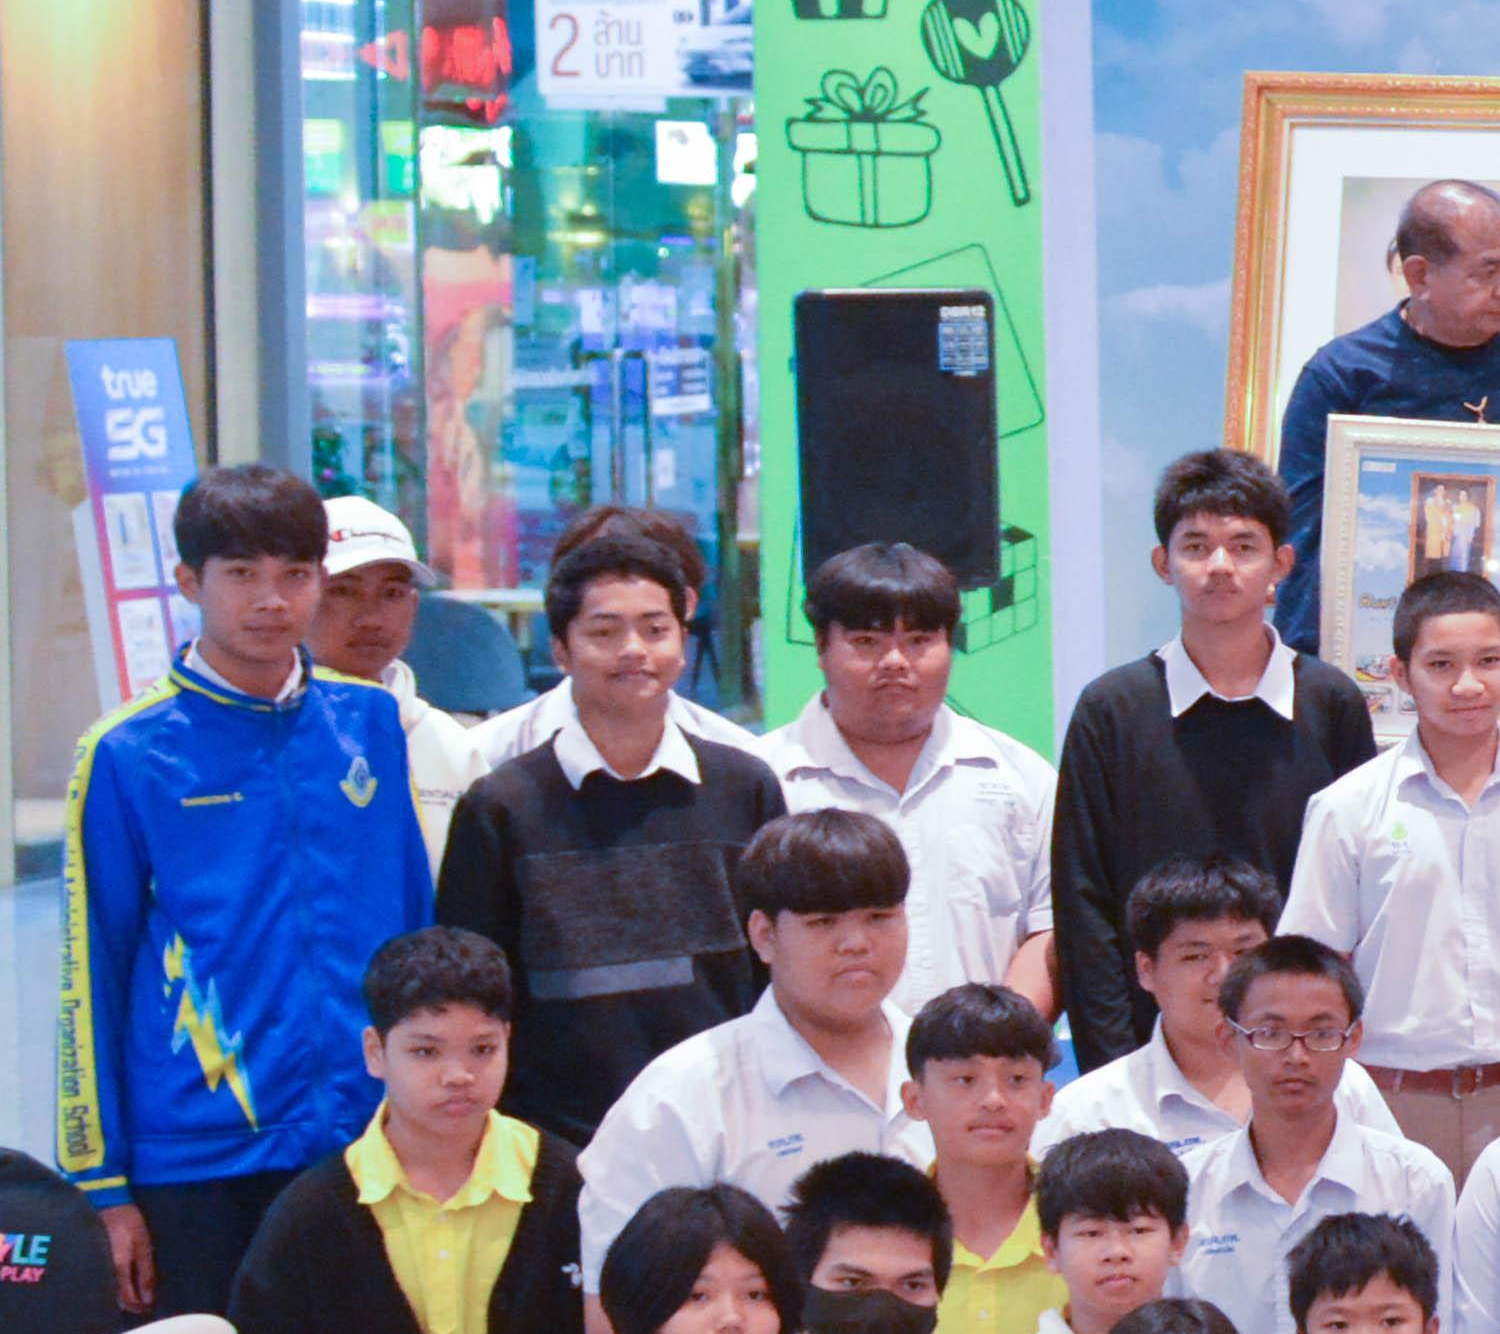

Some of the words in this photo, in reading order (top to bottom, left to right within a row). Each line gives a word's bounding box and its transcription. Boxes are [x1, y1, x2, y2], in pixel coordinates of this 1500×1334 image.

[549, 12, 580, 78] 2
[101, 364, 158, 400] true
[104, 408, 168, 461] 5G
